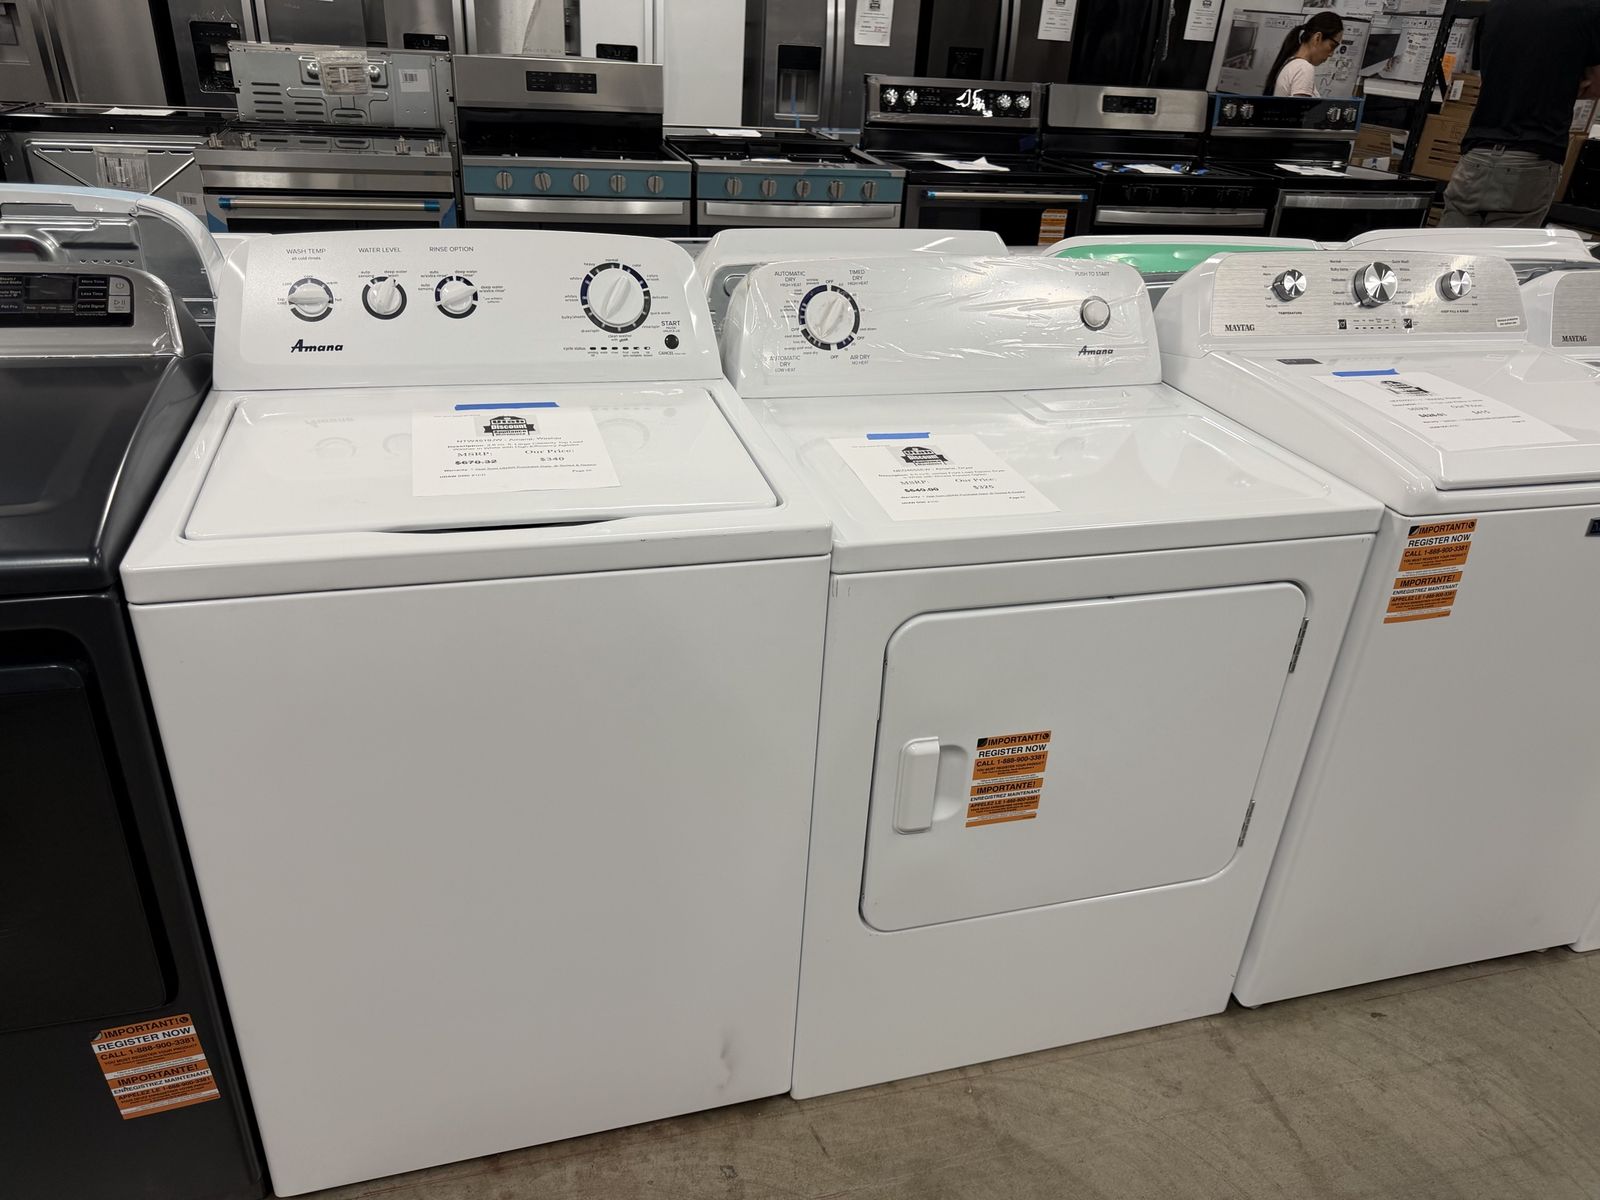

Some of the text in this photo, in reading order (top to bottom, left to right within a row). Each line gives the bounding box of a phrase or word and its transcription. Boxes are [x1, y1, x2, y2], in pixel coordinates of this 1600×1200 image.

[291, 339, 343, 353] Amana
[1078, 345, 1113, 356] Amana
[1419, 522, 1468, 534] IMPORTANT!
[1408, 533, 1471, 547] REGISTER NOW
[1424, 545, 1468, 555] 1-888-900-3381
[1400, 575, 1455, 587] IMPORTANTE!
[988, 734, 1042, 746] IMPORTANT!
[978, 744, 1047, 758] REGISTER NOW
[998, 754, 1045, 764] 1-888-900-3381
[976, 781, 1036, 794] IMPORTANTE!
[1007, 789, 1040, 797] MAINTENANT
[104, 1017, 179, 1039] IMPORTANT!
[97, 1027, 191, 1051] REGISTER NOW
[101, 1037, 195, 1060] CALL 1-888-900-3381
[132, 1052, 157, 1061] REGISTER
[117, 1063, 198, 1086] IMPORTANTE!
[113, 1070, 210, 1094] ENREGISTREZ MAINTENANT
[119, 1090, 150, 1100] APPELEZ
